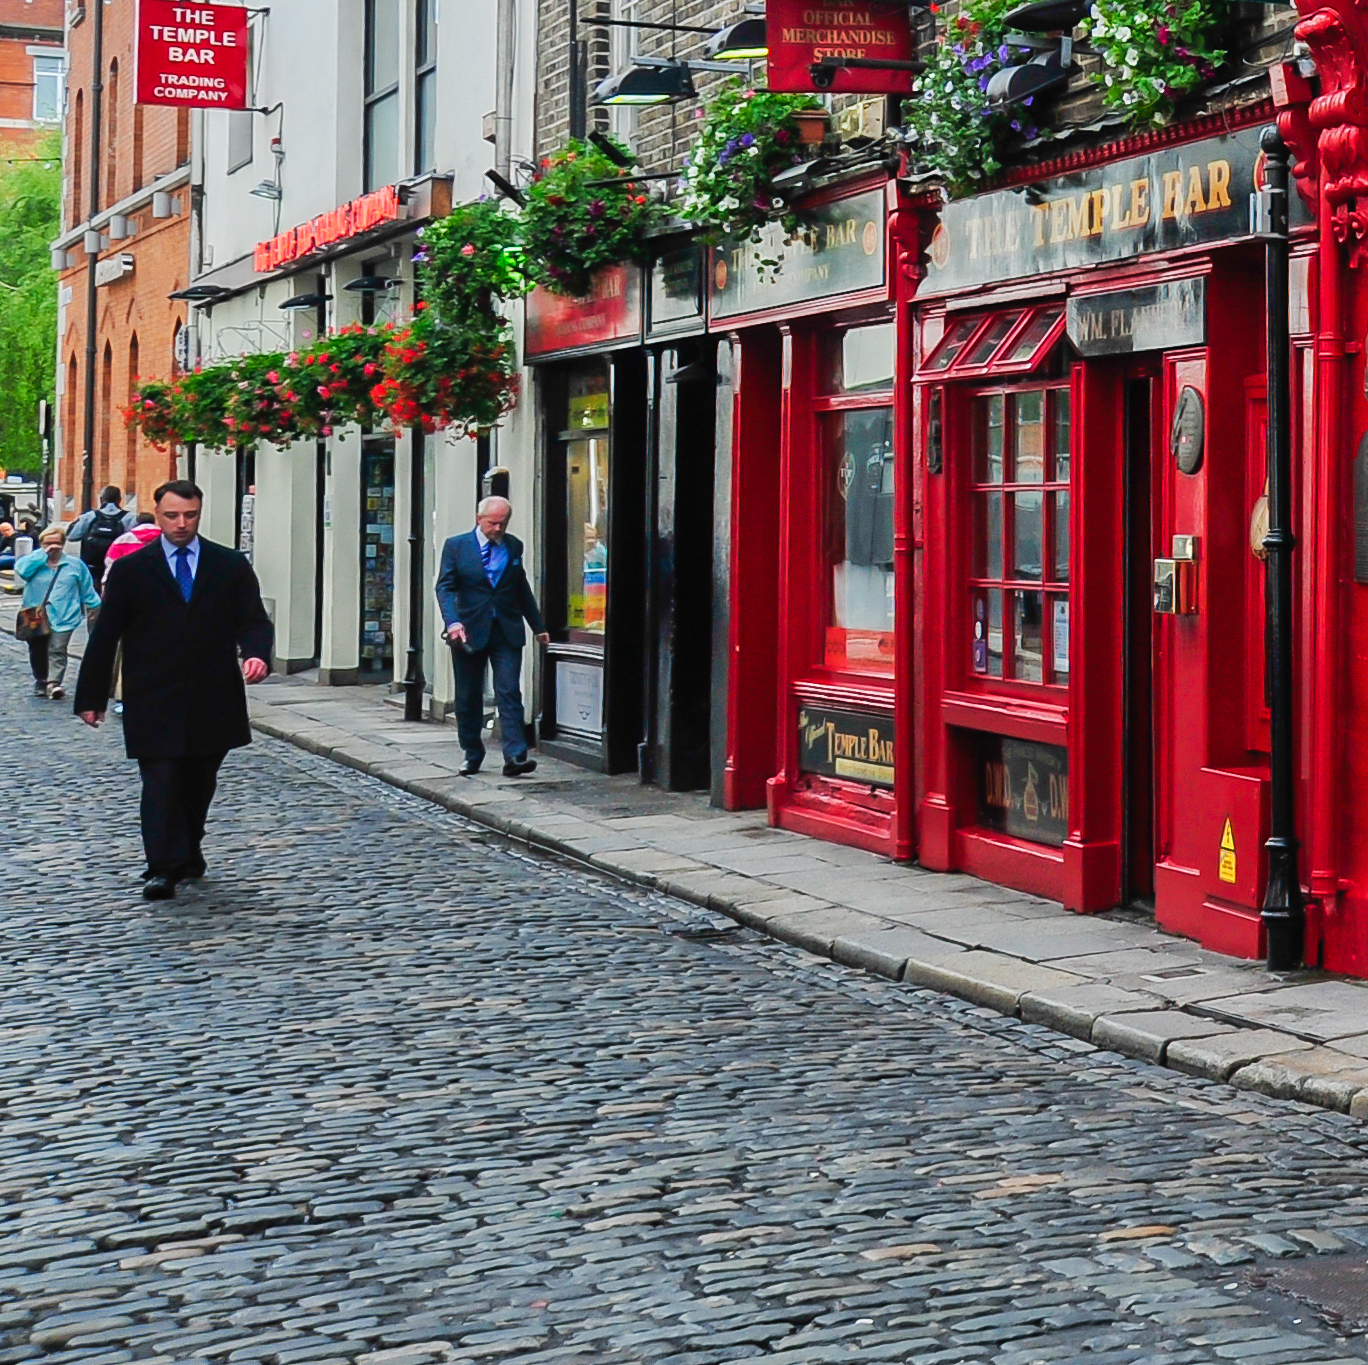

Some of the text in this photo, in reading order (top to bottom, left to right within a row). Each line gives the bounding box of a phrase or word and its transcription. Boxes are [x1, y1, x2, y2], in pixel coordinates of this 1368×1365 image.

[173, 7, 215, 25] THE
[803, 9, 874, 26] OFFICIAL
[149, 25, 237, 46] TEMPLE
[781, 27, 896, 45] MERCHANDISE
[168, 46, 216, 65] BAR
[159, 73, 226, 89] TRADING
[153, 87, 229, 101] COMPANY
[966, 159, 1233, 260] THE TEMPLE BAR
[826, 219, 857, 250] BAR
[826, 722, 868, 764] TEMPLE
